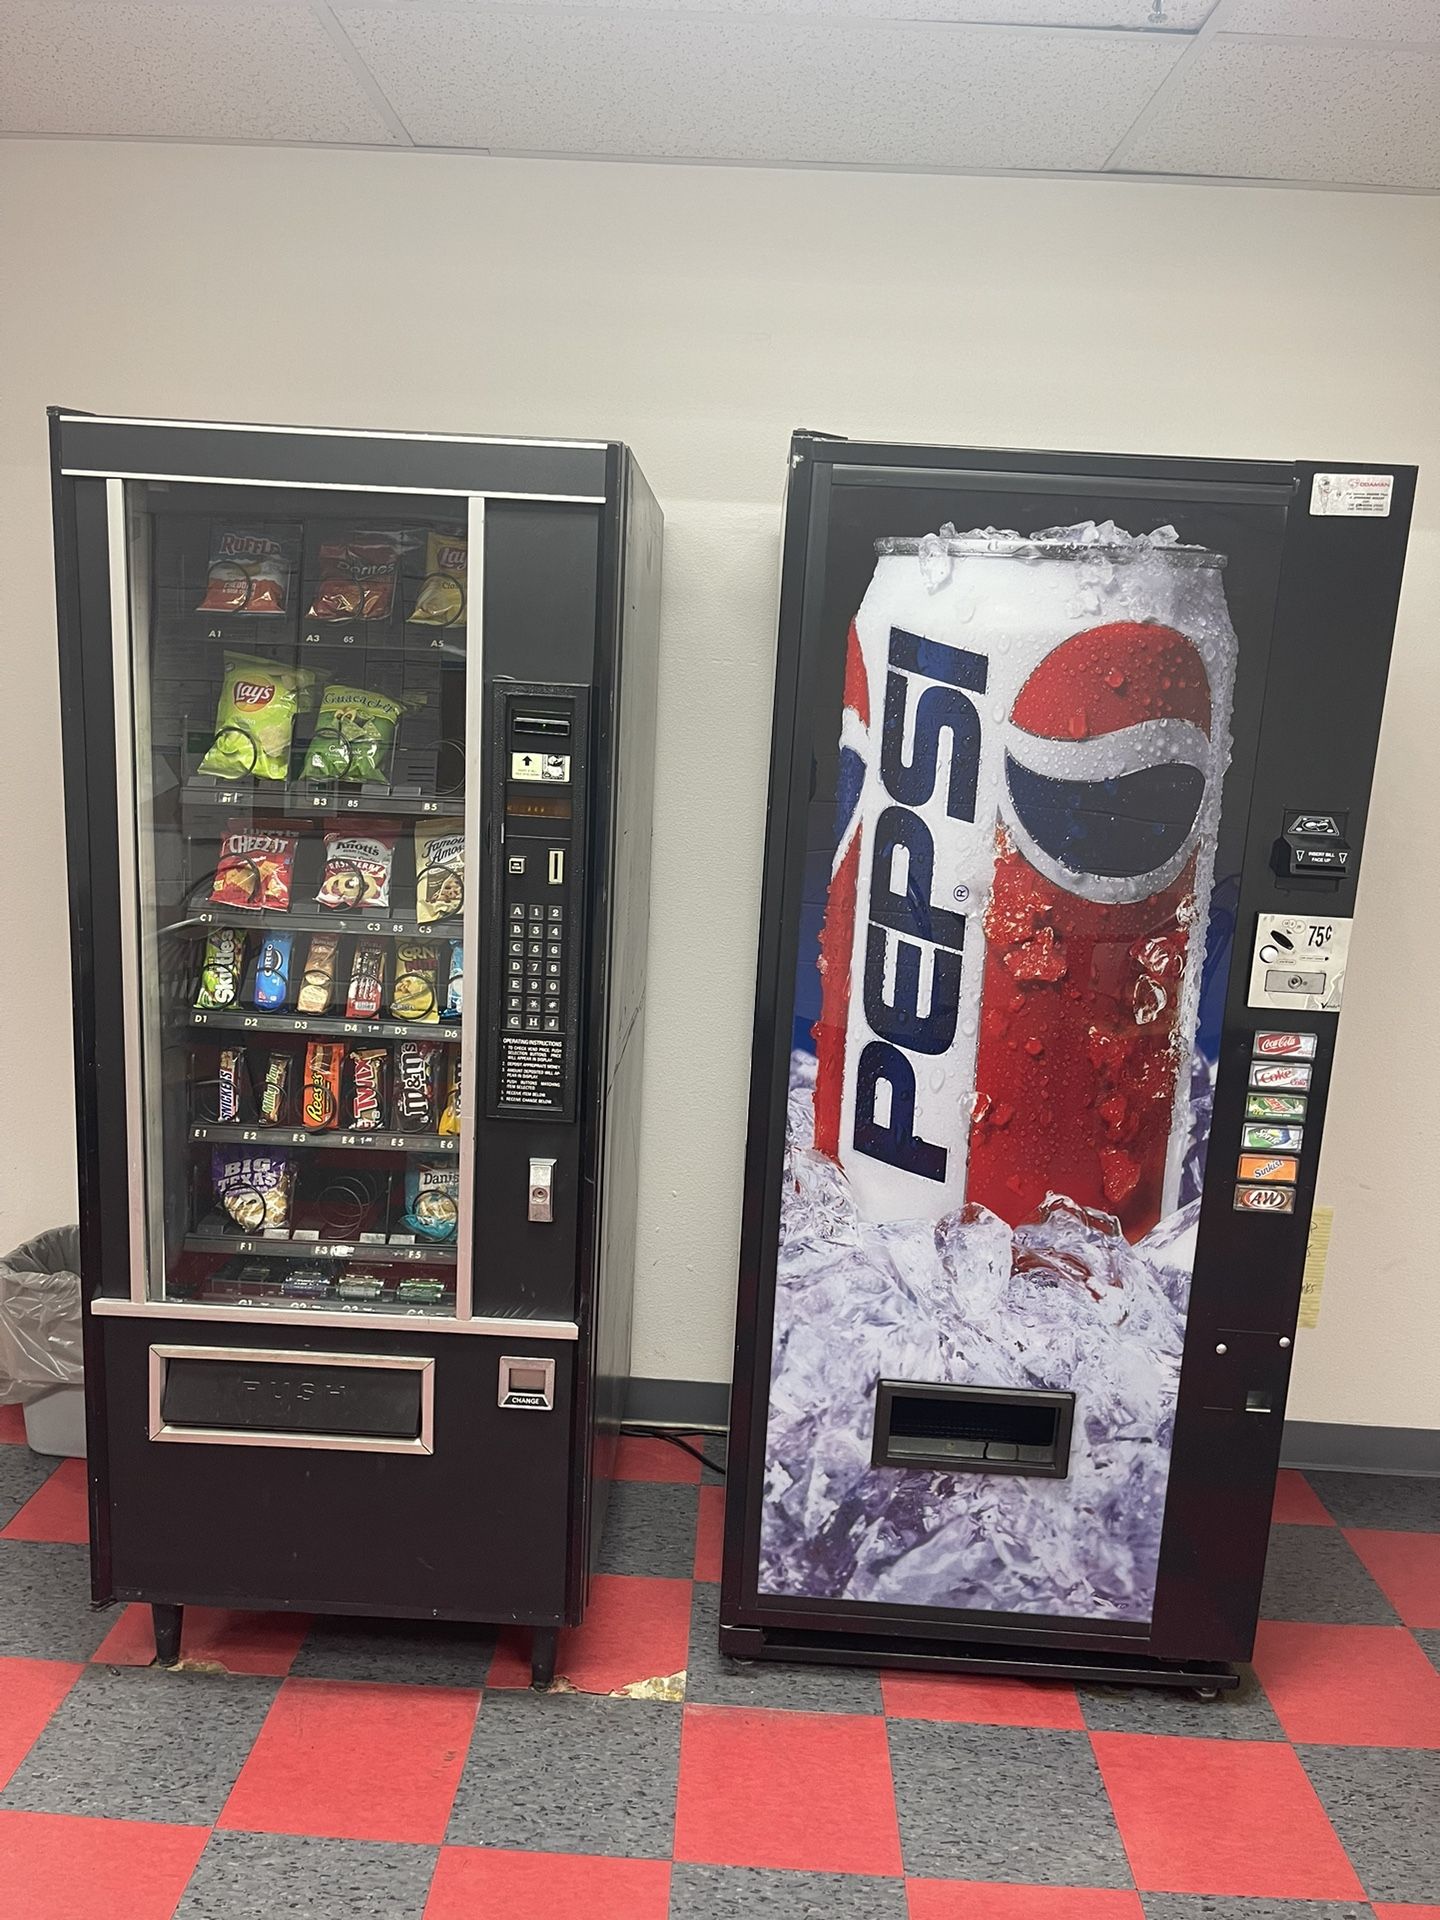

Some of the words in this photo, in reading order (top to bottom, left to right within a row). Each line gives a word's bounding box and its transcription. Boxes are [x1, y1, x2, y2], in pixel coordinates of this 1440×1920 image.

[438, 547, 467, 571] Lay
[208, 629, 222, 639] A1
[305, 633, 321, 643] A3
[343, 635, 355, 644] 65
[430, 639, 445, 648] A5
[236, 682, 274, 704] Lay's
[313, 797, 328, 807] B3
[347, 800, 359, 808] 85
[423, 802, 438, 811] B5
[335, 840, 380, 856] Knott's
[421, 835, 466, 859] Famou
[328, 860, 382, 873] RASERRY
[853, 625, 989, 1183] PEPSI
[513, 907, 522, 916] A
[534, 908, 540, 917] 1
[552, 909, 560, 917] 2
[199, 913, 213, 923] C1
[366, 924, 381, 932] C3
[393, 925, 404, 933] 85
[419, 926, 433, 934] C5
[513, 925, 521, 934] B
[533, 927, 540, 935] 3
[552, 928, 559, 936] 4
[1307, 925, 1333, 947] 75¢
[512, 943, 521, 952] C
[532, 945, 540, 953] 5
[551, 946, 558, 954] 6
[263, 943, 274, 977] OREO
[512, 962, 520, 971] D
[532, 963, 539, 972] 7
[551, 964, 558, 972] 8
[511, 980, 520, 989] E
[531, 982, 538, 990] 9
[550, 983, 557, 991] 0
[511, 998, 519, 1007] F
[194, 1014, 208, 1023] D1
[244, 1018, 258, 1027] D2
[510, 1016, 519, 1025] G
[529, 1018, 538, 1026] H
[549, 1019, 556, 1027] J
[294, 1021, 308, 1030] D3
[344, 1024, 358, 1032] D4
[394, 1027, 408, 1035] D5
[444, 1030, 458, 1038] D6
[265, 1063, 282, 1084] Way
[353, 1059, 379, 1119] TWIX
[261, 1084, 280, 1114] Milky
[306, 1072, 324, 1122] Reese's
[194, 1129, 207, 1138] E1
[243, 1131, 257, 1140] E2
[292, 1133, 306, 1142] E3
[341, 1136, 355, 1144] E4
[390, 1138, 404, 1147] E5
[440, 1140, 454, 1149] E6
[224, 1158, 271, 1177] BIG
[1254, 1159, 1284, 1178] Sunkist
[217, 1172, 278, 1193] TEXAS
[423, 1172, 460, 1186] Danis
[240, 1242, 252, 1251] F1
[314, 1246, 328, 1255] F3
[408, 1251, 422, 1260] F5
[511, 1396, 540, 1406] CHANGE
